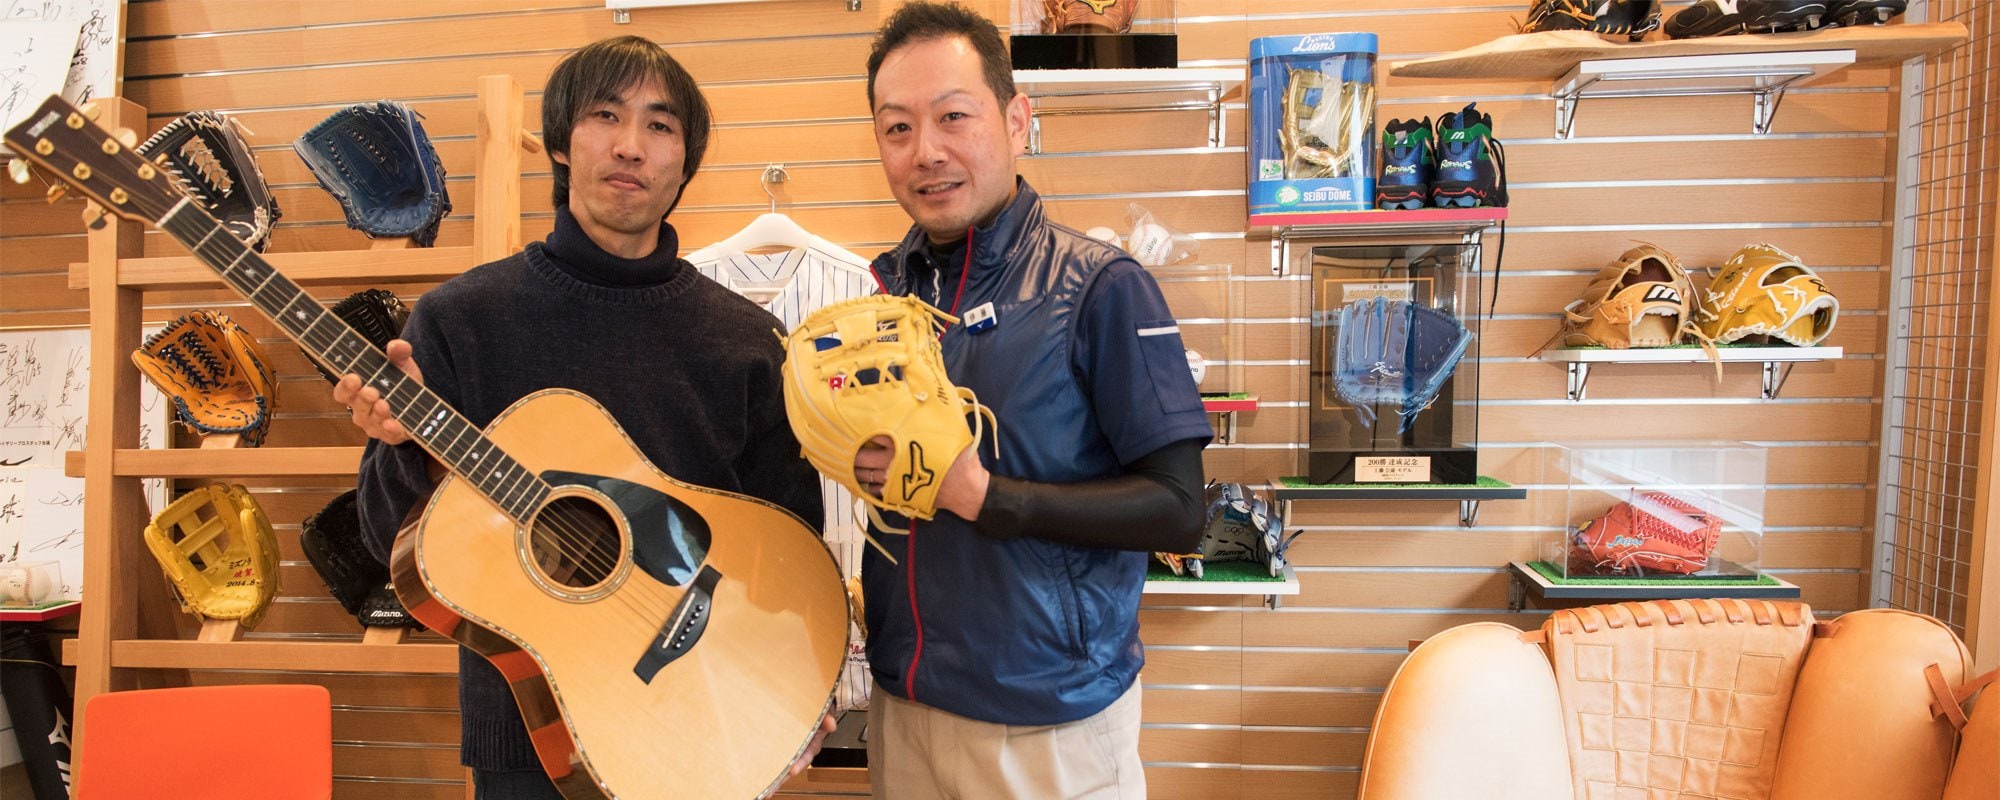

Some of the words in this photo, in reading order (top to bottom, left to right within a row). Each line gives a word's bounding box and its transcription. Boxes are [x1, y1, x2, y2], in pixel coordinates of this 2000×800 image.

[1292, 35, 1336, 52] Lions
[1303, 191, 1326, 202] SEIBU
[1328, 190, 1352, 201] DOME
